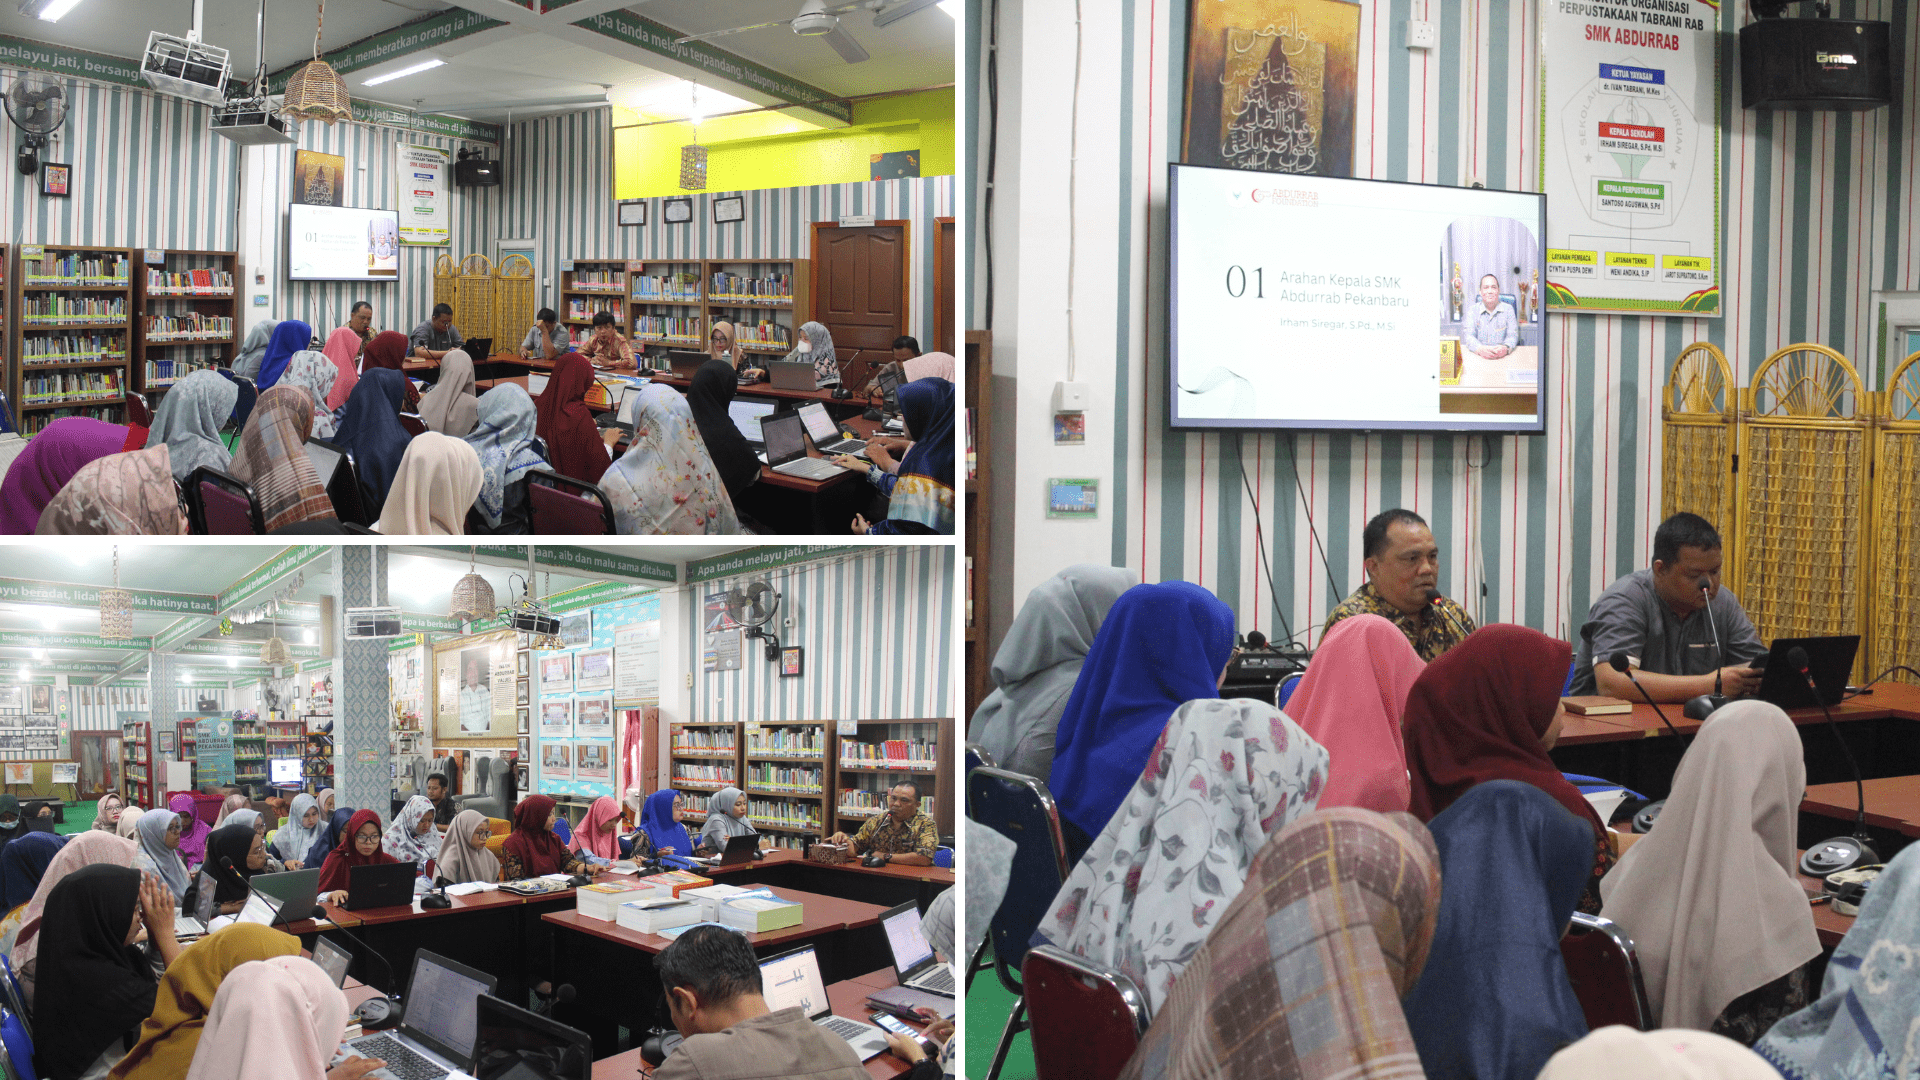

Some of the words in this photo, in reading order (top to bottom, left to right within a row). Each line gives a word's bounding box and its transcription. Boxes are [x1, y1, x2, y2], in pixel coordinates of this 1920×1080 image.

[1631, 0, 1689, 14] ORGANISASI
[1559, 1, 1638, 22] PERPUSTAKAAN
[1641, 12, 1682, 28] TABRANI
[1685, 18, 1704, 31] RAB
[355, 36, 418, 66] memberatkan
[420, 22, 452, 44] orang
[454, 14, 464, 30] ia
[1585, 24, 1611, 43] SMK
[1614, 27, 1680, 51] ABDURRAB
[52, 53, 81, 70] jati,
[616, 19, 649, 43] tanda
[651, 34, 689, 57] melayu
[690, 48, 744, 79] terpandang,
[745, 66, 780, 91] hidupnya
[1611, 68, 1629, 78] KETUA
[1630, 70, 1653, 81] YAYASAN
[1611, 83, 1622, 91] IVAN
[1623, 84, 1646, 95] TABRANI,
[1646, 87, 1661, 96] M.Kes
[427, 118, 450, 132] tekun
[451, 121, 459, 132] di
[459, 124, 479, 136] jalan
[1609, 127, 1630, 137] KEPALA
[1630, 129, 1655, 139] SEKOLAH
[1600, 139, 1617, 148] IRHAM
[1617, 141, 1639, 151] SIREGAR,
[1272, 188, 1319, 200] ABDURRAB
[1603, 184, 1621, 193] KEPALA
[1622, 186, 1660, 196] PERPUSTAKAAN
[1602, 198, 1624, 207] SANTOSO
[1650, 202, 1661, 210] S.Pd
[305, 232, 317, 243] 01
[1551, 252, 1571, 260] LAYANAN
[1613, 256, 1632, 264] LAYANAN
[1566, 266, 1581, 274] PUSPA
[1226, 265, 1266, 299] 01
[1280, 271, 1326, 285] Arahan
[1329, 274, 1371, 289] Kepala
[1374, 276, 1402, 289] SMK
[1280, 289, 1341, 305] Abdurrab
[1344, 293, 1409, 307] Pekanbaru
[1280, 318, 1309, 328] Irham
[1311, 319, 1348, 331] Siregar,
[1377, 322, 1396, 331] M.Si
[558, 550, 573, 562] aib
[575, 552, 593, 565] dan
[594, 556, 616, 569] malu
[617, 560, 640, 573] sama
[640, 563, 674, 579] ditahan.
[697, 565, 715, 576] Apa
[716, 560, 743, 572] tanda
[745, 551, 782, 567] melayu
[783, 547, 804, 561] jati,
[21, 586, 72, 601] beradat,
[150, 598, 189, 611] hatinya
[190, 601, 214, 611] taat.
[427, 619, 458, 629] berbakti
[41, 635, 63, 645] jujur
[102, 638, 118, 648] jadi
[118, 638, 150, 648] pakaian.
[181, 643, 197, 651] Adat
[198, 644, 218, 652] hidup
[240, 645, 263, 654] berbud
